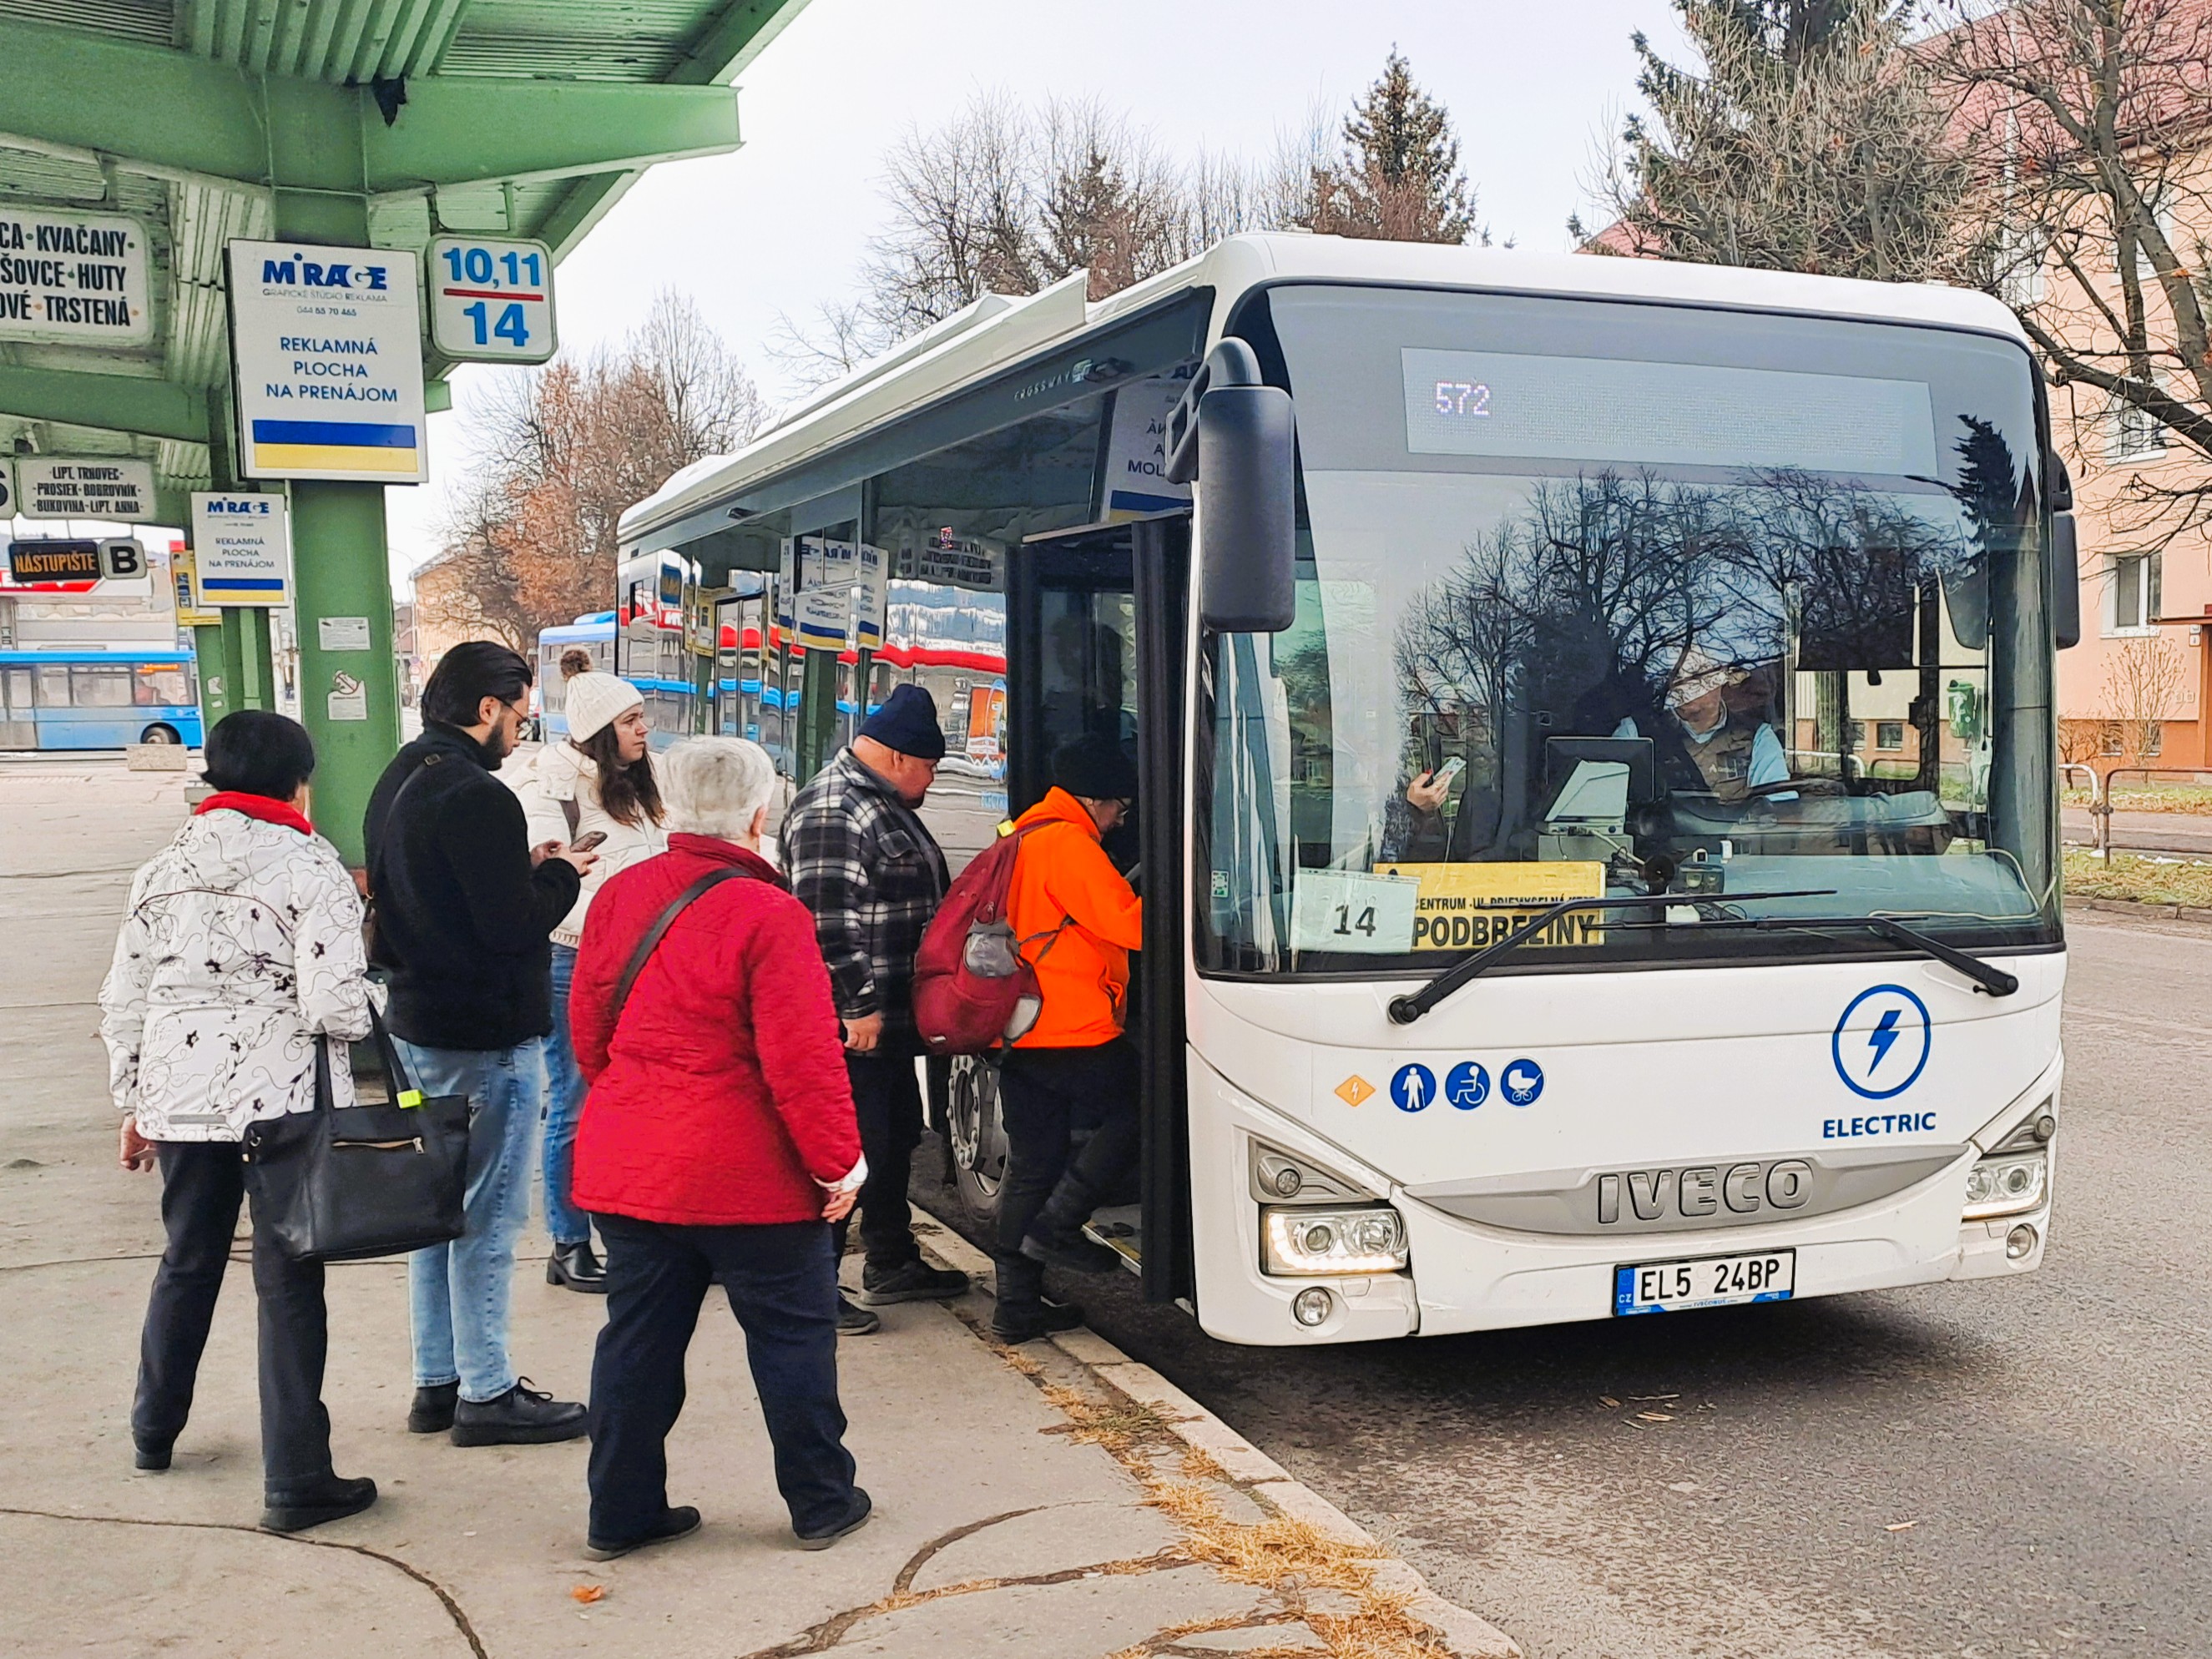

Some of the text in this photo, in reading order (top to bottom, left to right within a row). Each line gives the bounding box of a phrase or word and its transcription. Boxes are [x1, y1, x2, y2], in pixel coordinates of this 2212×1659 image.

[36, 223, 127, 258] KVAČANY
[78, 263, 127, 291] HUTY
[442, 248, 539, 289] 10,11
[43, 295, 130, 326] TRSTENÁ
[463, 301, 529, 347] 14
[280, 336, 378, 356] REKLAMNÁ
[294, 361, 368, 378] PLOCHA
[266, 382, 397, 402] NA PRENÁJOM
[1436, 381, 1490, 415] 572
[78, 466, 119, 481] TRNOVEC
[38, 482, 78, 496] PROSIEK
[37, 499, 85, 512] BUKOVINA
[114, 501, 140, 513] ANNA
[215, 536, 265, 546] REKLAMNÁ
[222, 548, 260, 557] PLOCHA
[14, 546, 138, 574] NÁSTUPIŠTE B
[225, 558, 275, 568] PRENÁJOM
[1334, 905, 1376, 936] 14
[1823, 1112, 1937, 1138] ELECTRIC
[1598, 1159, 1815, 1224] IVECO
[1619, 1258, 1780, 1304] CZ EL5 24BP
